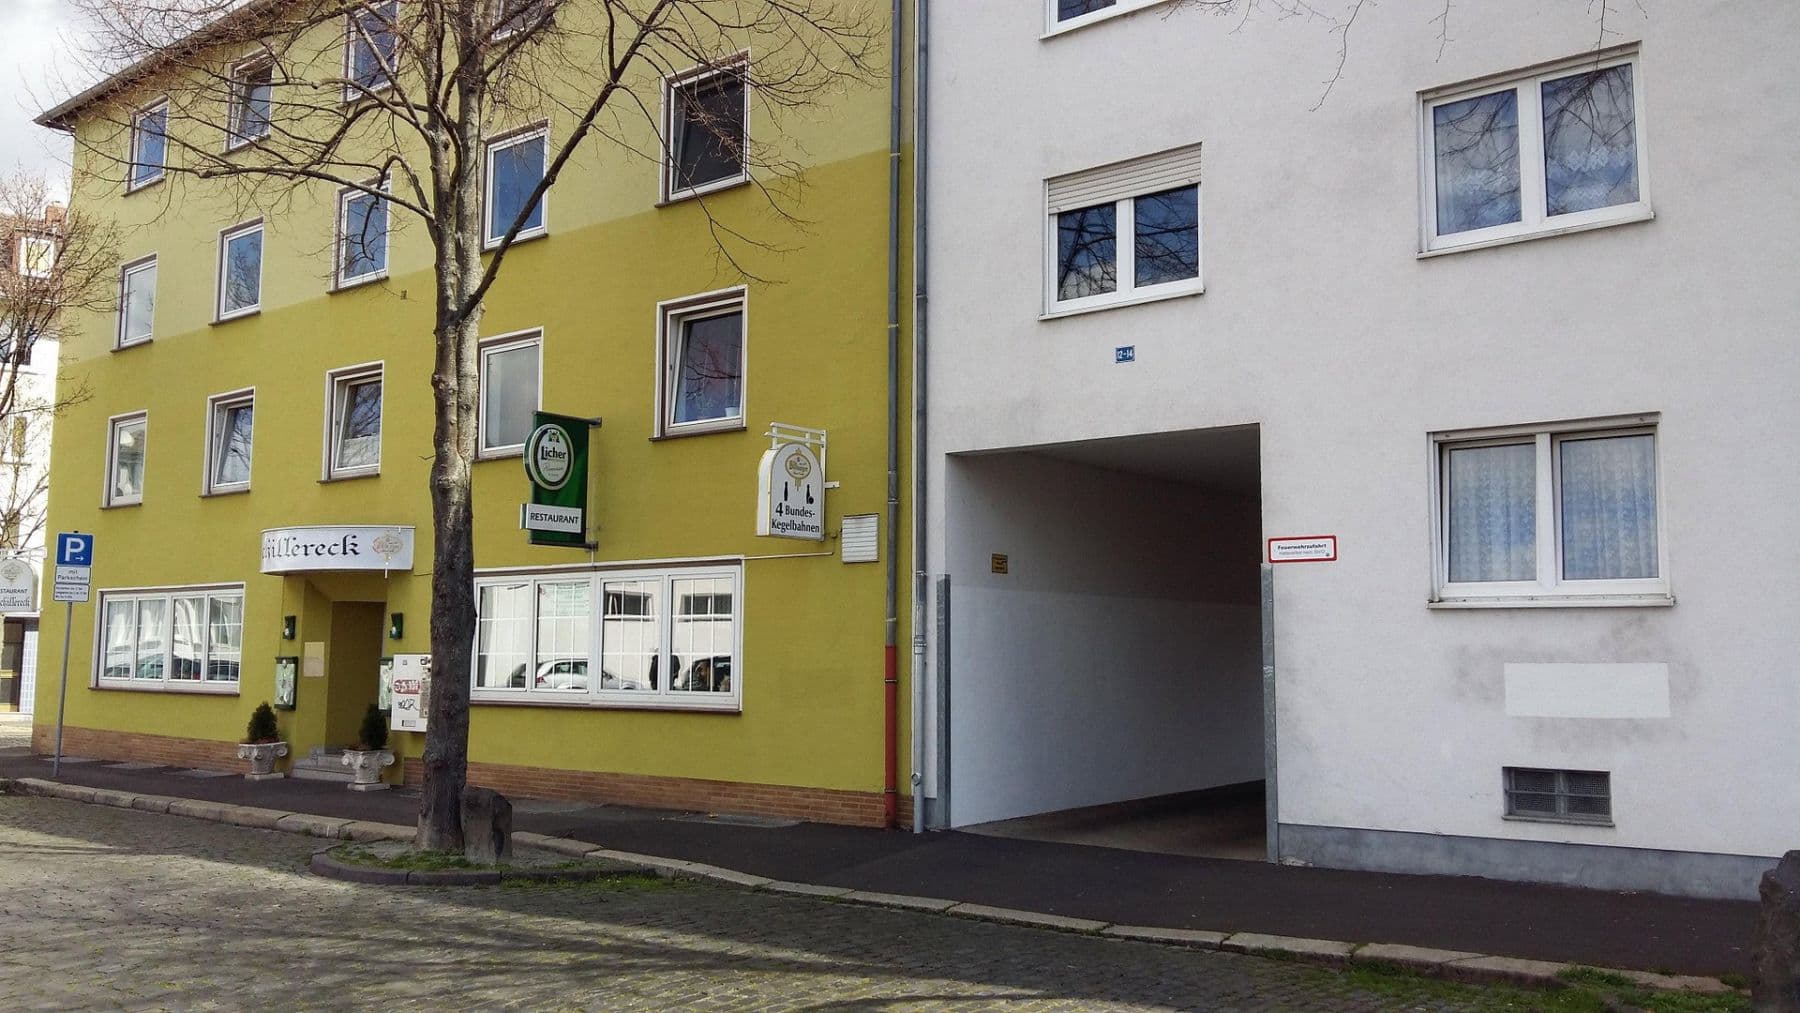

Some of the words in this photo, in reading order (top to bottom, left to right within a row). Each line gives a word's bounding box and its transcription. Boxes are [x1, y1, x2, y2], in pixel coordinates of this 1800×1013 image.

[541, 446, 567, 460] Licher
[776, 502, 783, 517] 4
[785, 505, 815, 518] Bundes-
[530, 512, 579, 524] RESTAURANT
[771, 519, 819, 533] Kegelbahnen
[65, 537, 85, 562] P
